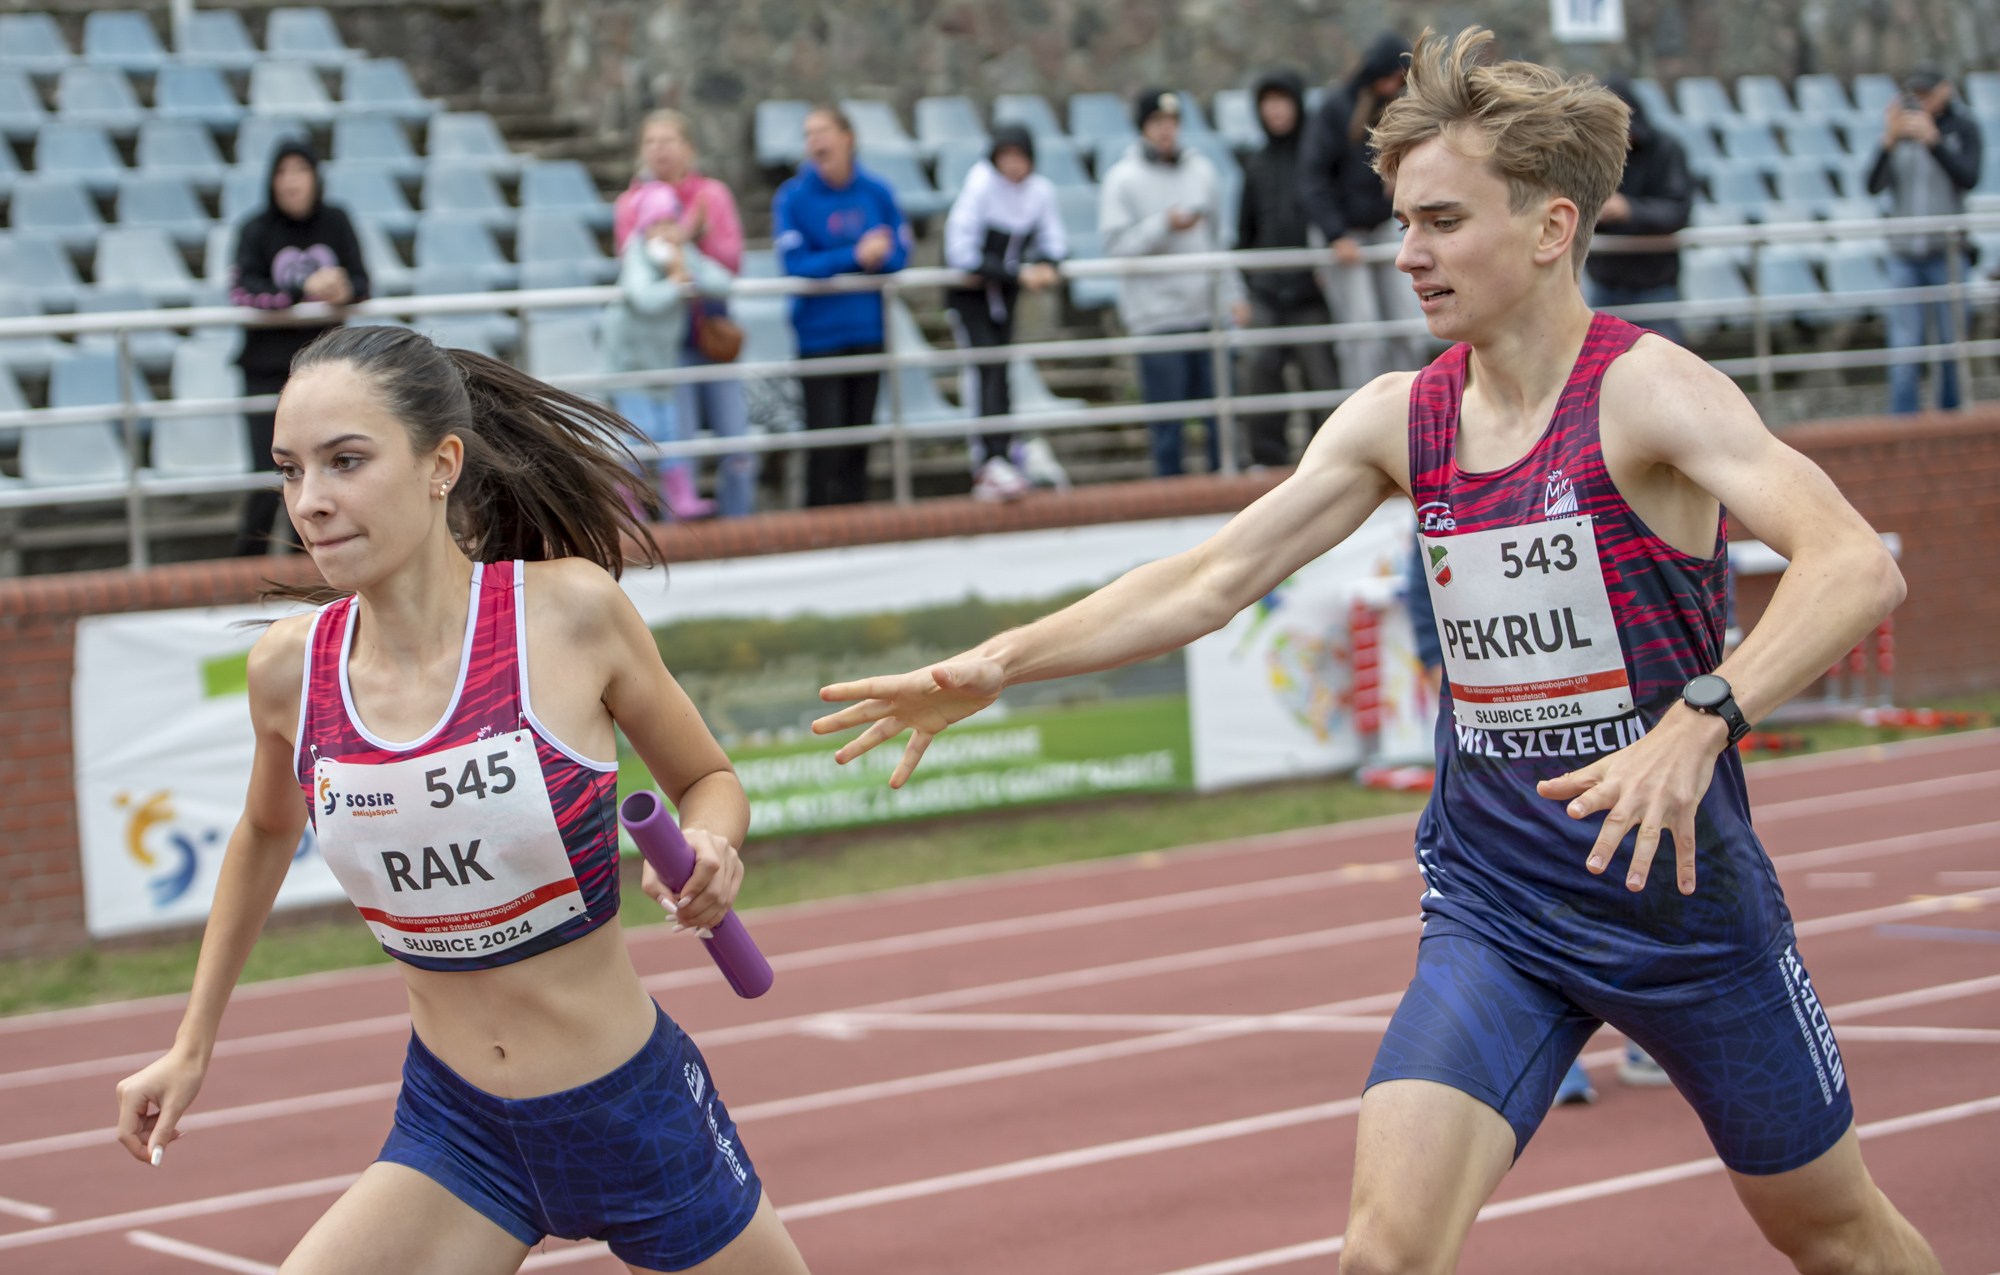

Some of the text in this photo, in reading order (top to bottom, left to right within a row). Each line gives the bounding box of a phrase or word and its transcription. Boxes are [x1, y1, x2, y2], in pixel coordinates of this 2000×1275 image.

[1500, 533, 1578, 579] 543
[1442, 607, 1592, 661] PEKRUL
[1473, 686, 1505, 694] Mistrzostwa
[1505, 684, 1522, 693] Polski
[1530, 679, 1575, 691] Wielobojach
[1574, 675, 1588, 685] U16
[1492, 696, 1506, 704] oraz
[1512, 691, 1548, 702] Sztafetach
[1475, 701, 1583, 724] SŁUBICE 2024
[1502, 715, 1647, 760] SZCZECIN
[424, 750, 517, 809] 545
[345, 792, 395, 808] SOSiR
[351, 808, 399, 818] #MisjaSport
[380, 838, 496, 893] RAK
[398, 917, 439, 926] Mistrzostwa
[439, 913, 462, 924] Polski
[463, 914, 470, 922] w
[470, 899, 522, 920] Wielobojach
[521, 890, 536, 903] U16
[402, 919, 533, 953] SŁUBICE 2024
[424, 920, 492, 934] oraz w Sztafetach
